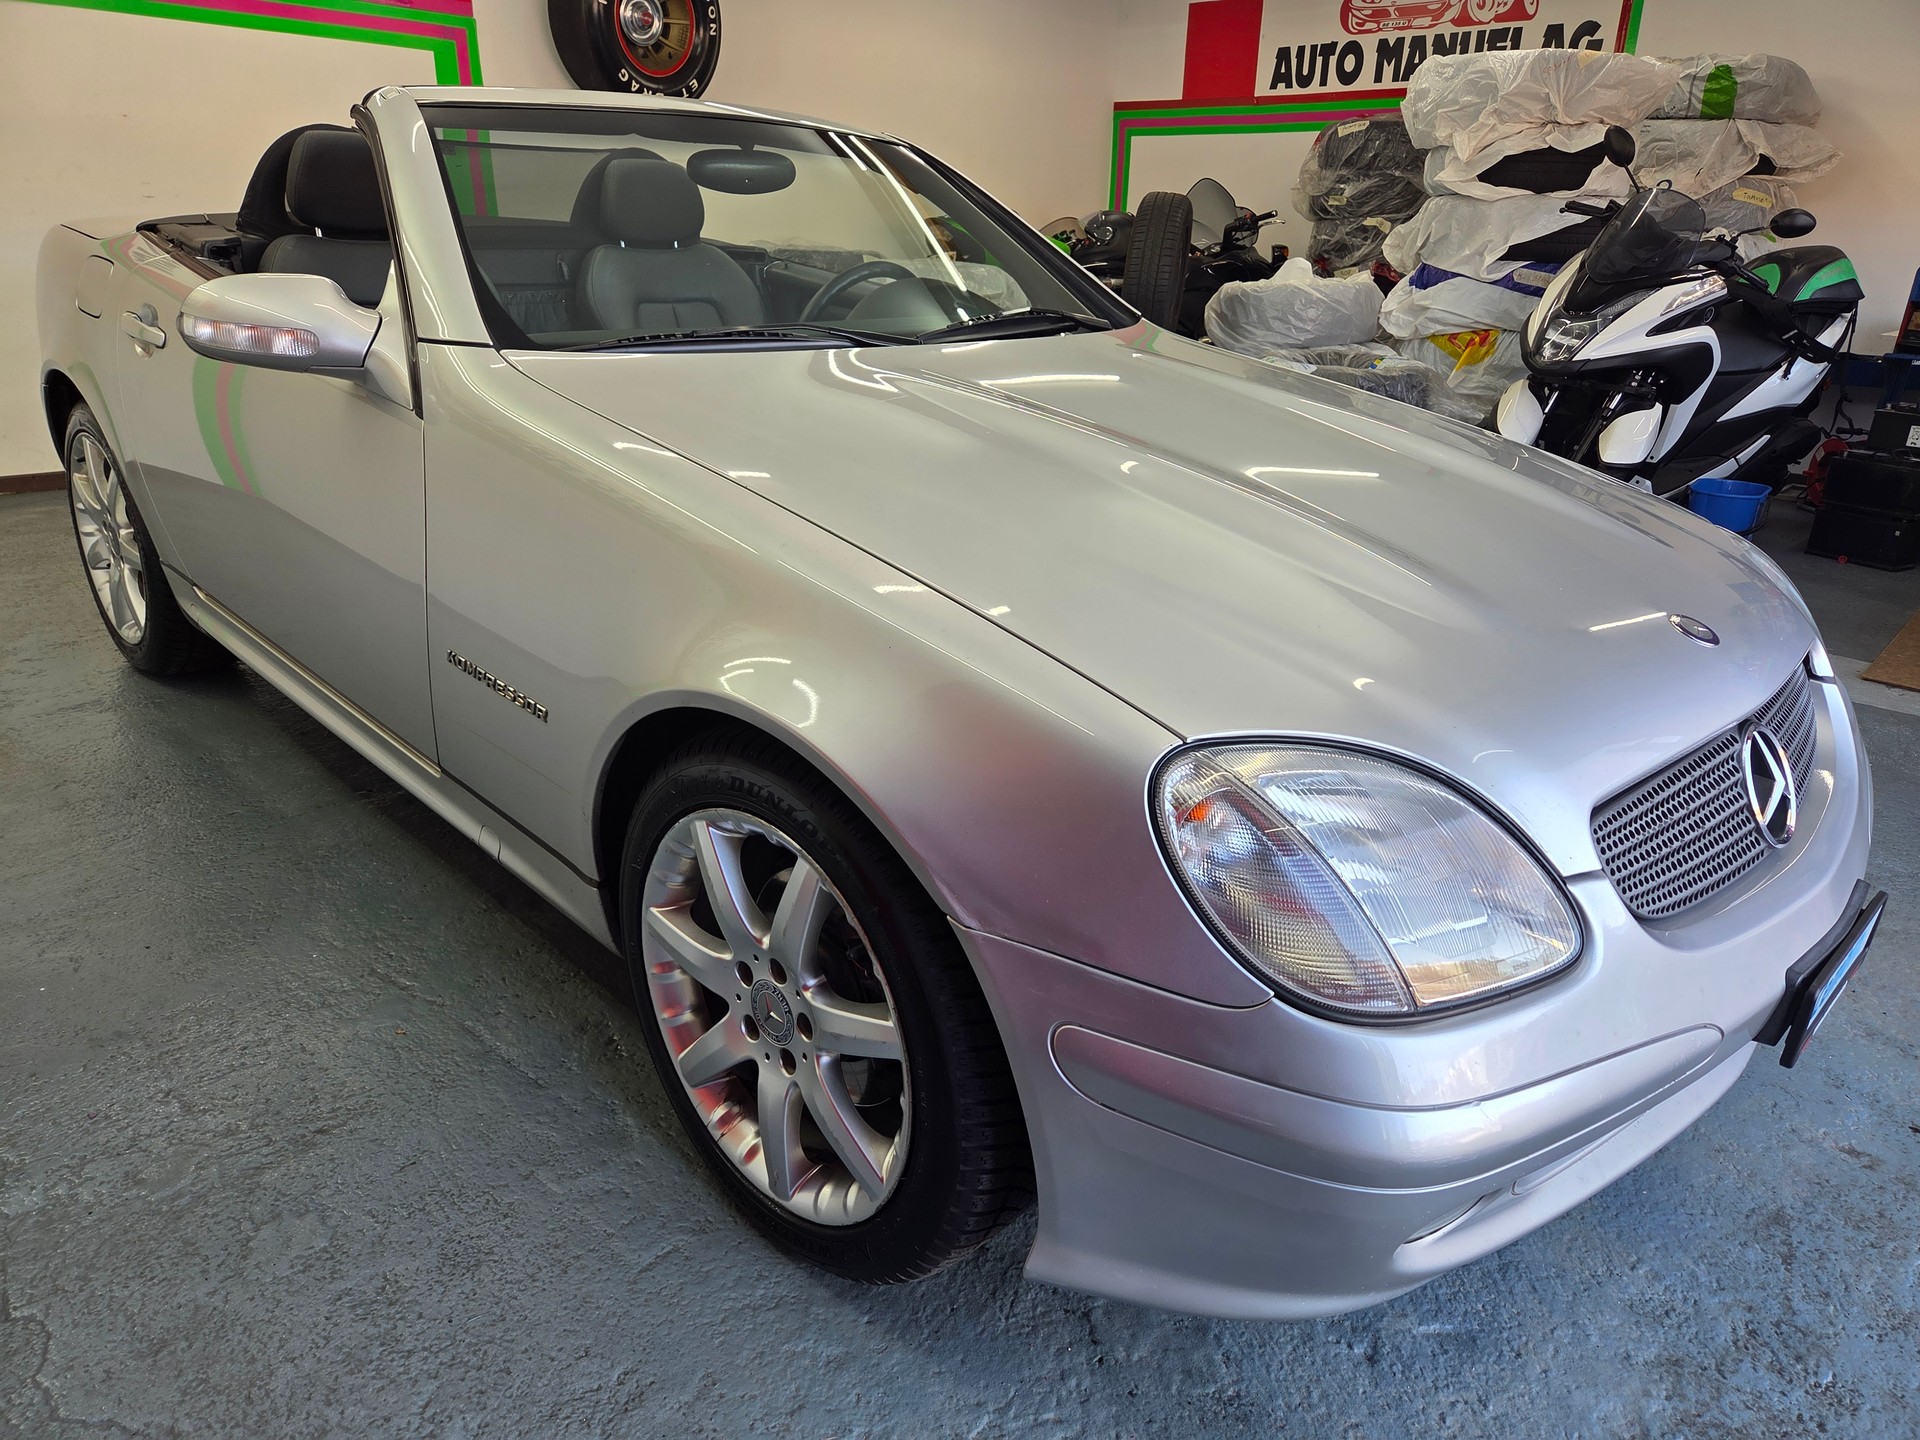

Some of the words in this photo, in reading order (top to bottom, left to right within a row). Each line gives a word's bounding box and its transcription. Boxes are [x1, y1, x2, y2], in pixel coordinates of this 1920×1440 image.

[1269, 39, 1365, 90] AUTO
[1541, 20, 1604, 51] AG
[446, 648, 549, 724] KOMPRESSOR
